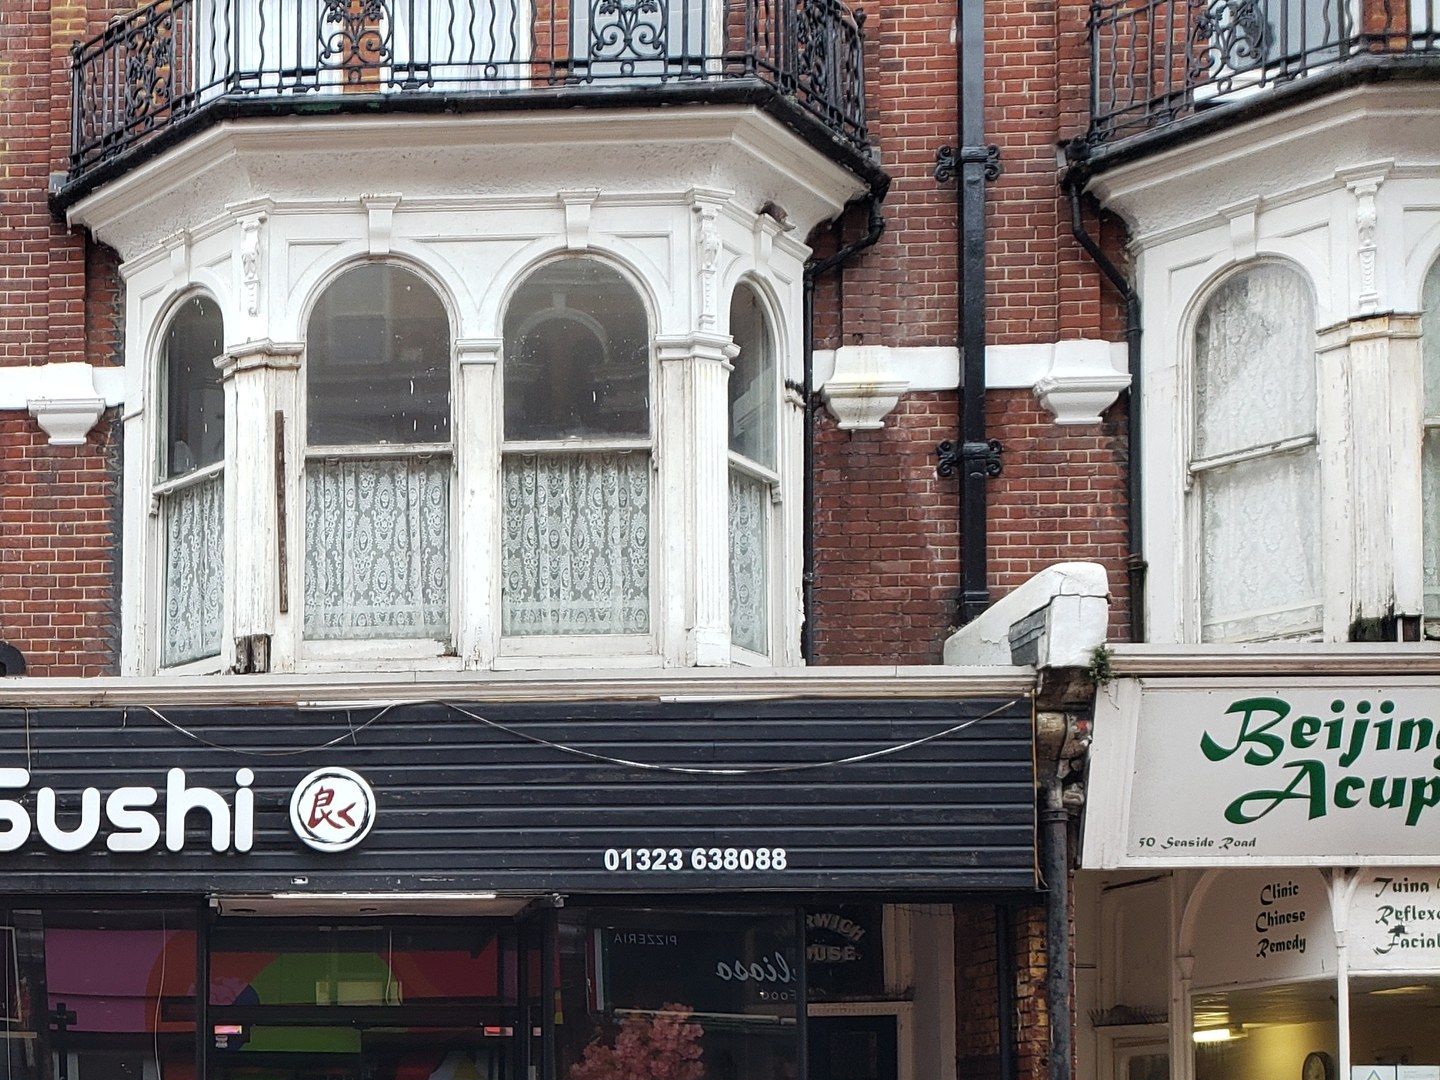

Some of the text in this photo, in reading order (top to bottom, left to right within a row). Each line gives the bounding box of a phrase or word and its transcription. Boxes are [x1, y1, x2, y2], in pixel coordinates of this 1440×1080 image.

[1200, 697, 1440, 770] Beijin
[1139, 836, 1257, 849] 50 Seaside Road
[604, 847, 787, 871] 01323 638088
[1260, 881, 1299, 905] Clinic
[1373, 877, 1430, 898] Tuina
[1255, 910, 1306, 933] Chinese
[1256, 933, 1306, 958] Remedy
